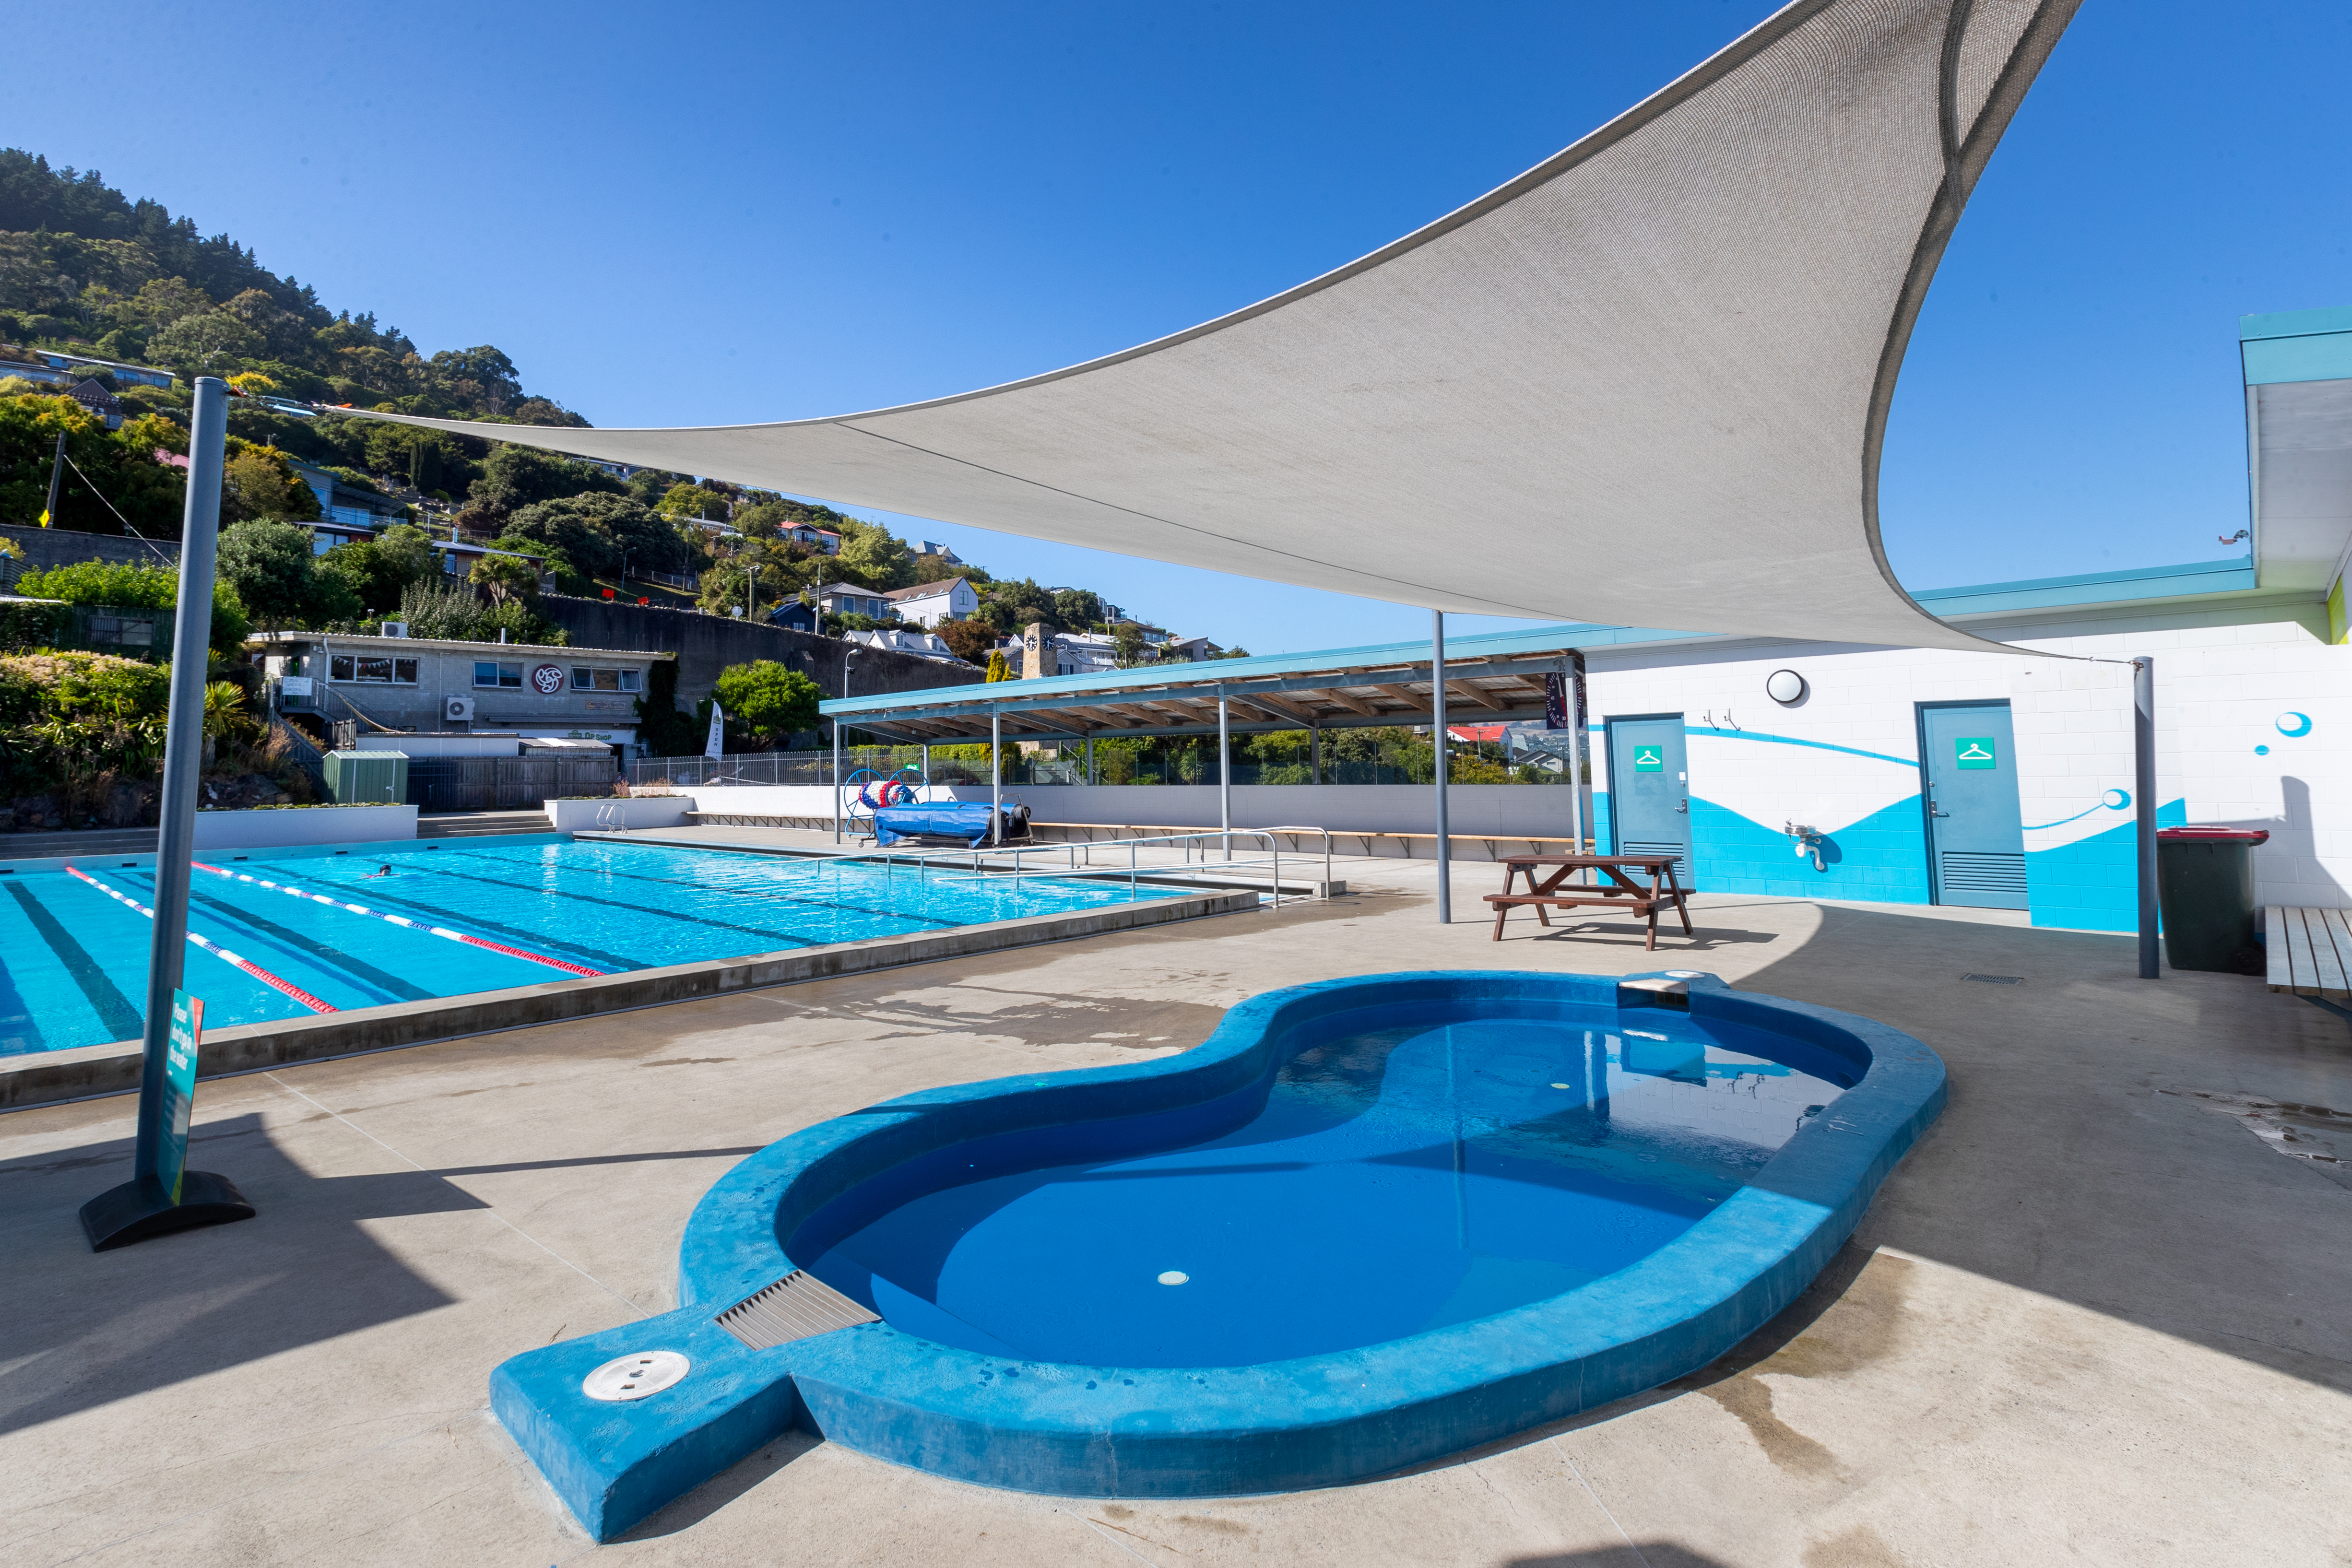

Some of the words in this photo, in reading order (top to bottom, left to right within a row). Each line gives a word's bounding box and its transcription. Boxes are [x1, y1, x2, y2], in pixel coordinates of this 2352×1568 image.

[174, 1002, 187, 1024] Please
[172, 1023, 183, 1044] don't
[180, 1033, 188, 1050] go
[187, 1031, 192, 1050] in
[176, 1052, 189, 1071] water
